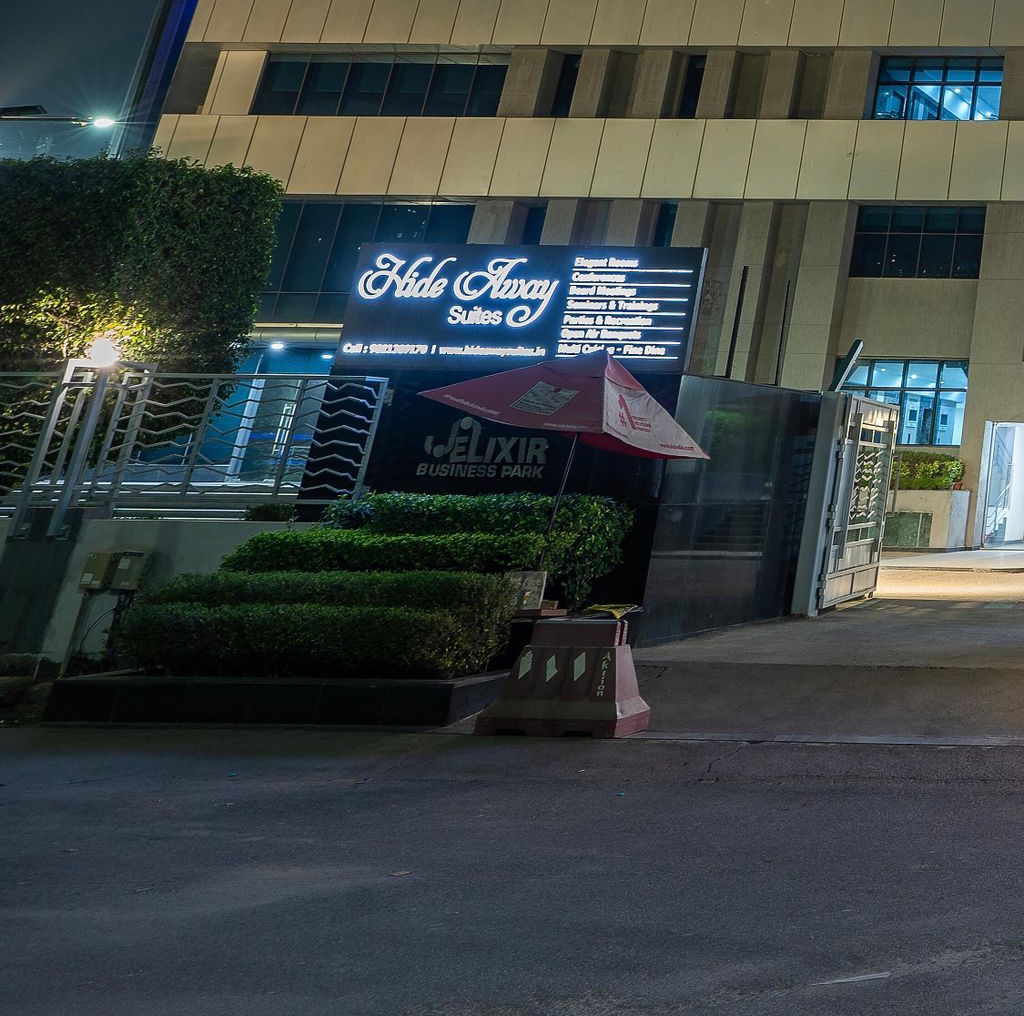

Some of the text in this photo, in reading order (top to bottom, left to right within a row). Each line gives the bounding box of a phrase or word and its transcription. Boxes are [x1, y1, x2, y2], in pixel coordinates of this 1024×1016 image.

[358, 253, 560, 328] Hide Away
[447, 305, 503, 325] Suites
[343, 343, 364, 354] Call
[416, 463, 545, 478] BUSINESS PARK
